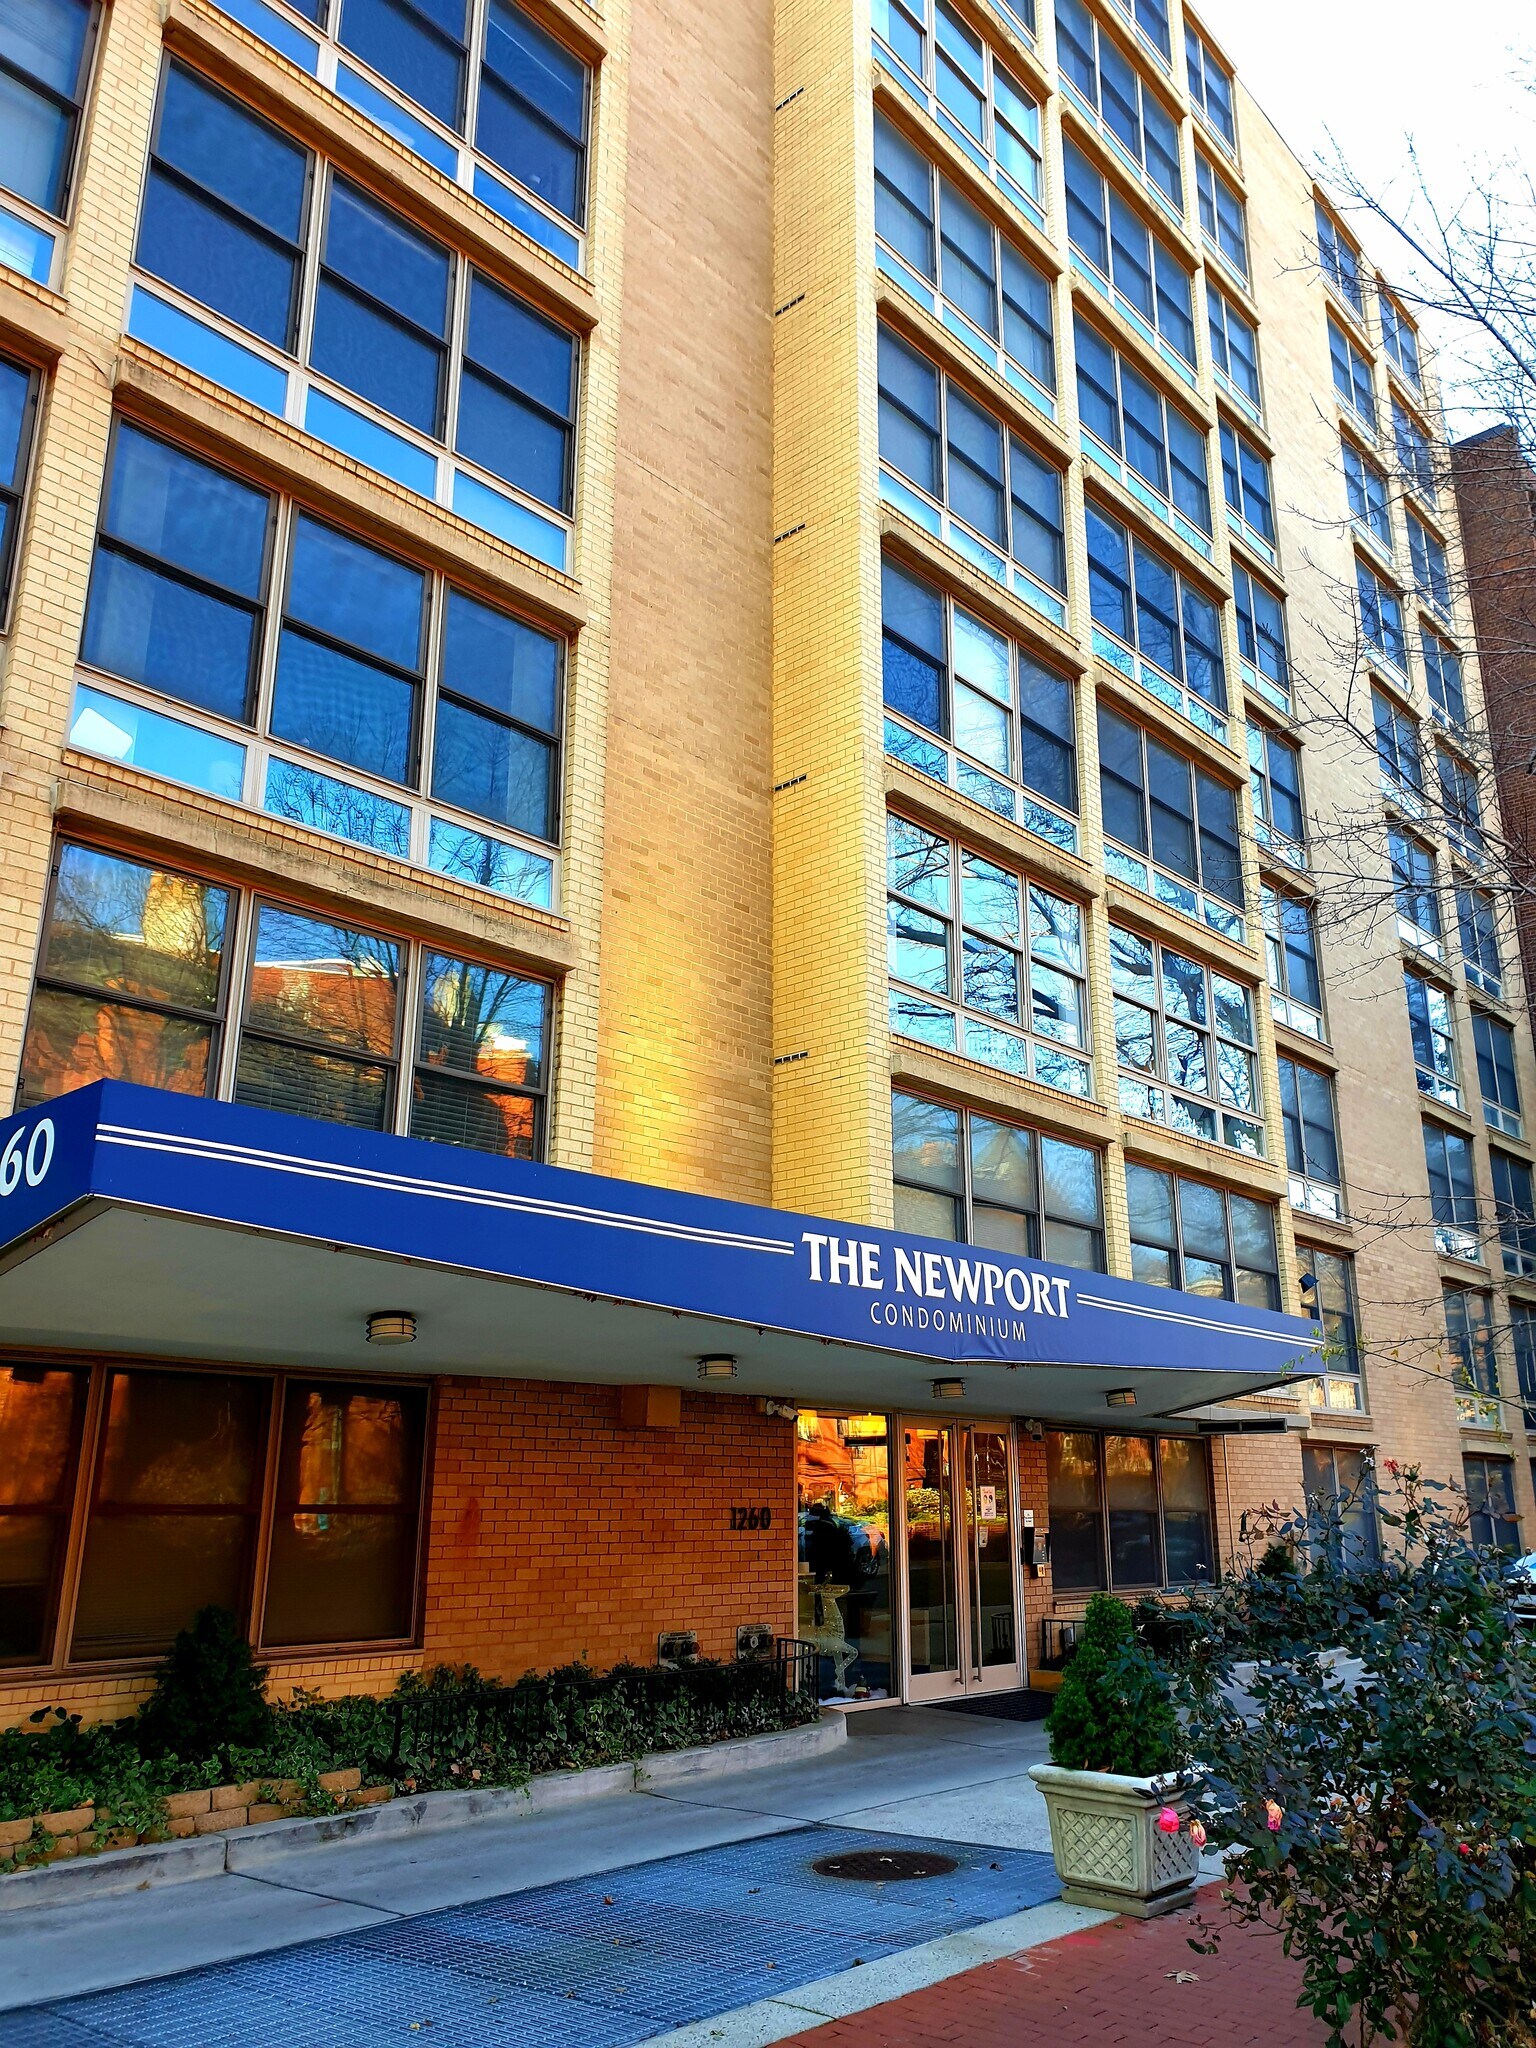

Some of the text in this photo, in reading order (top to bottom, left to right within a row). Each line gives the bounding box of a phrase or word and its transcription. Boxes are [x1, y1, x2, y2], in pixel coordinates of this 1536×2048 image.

[801, 1232, 1070, 1319] THE NEWPORT
[870, 1301, 1026, 1342] CONDOMINIUM
[730, 1506, 771, 1530] 1260
